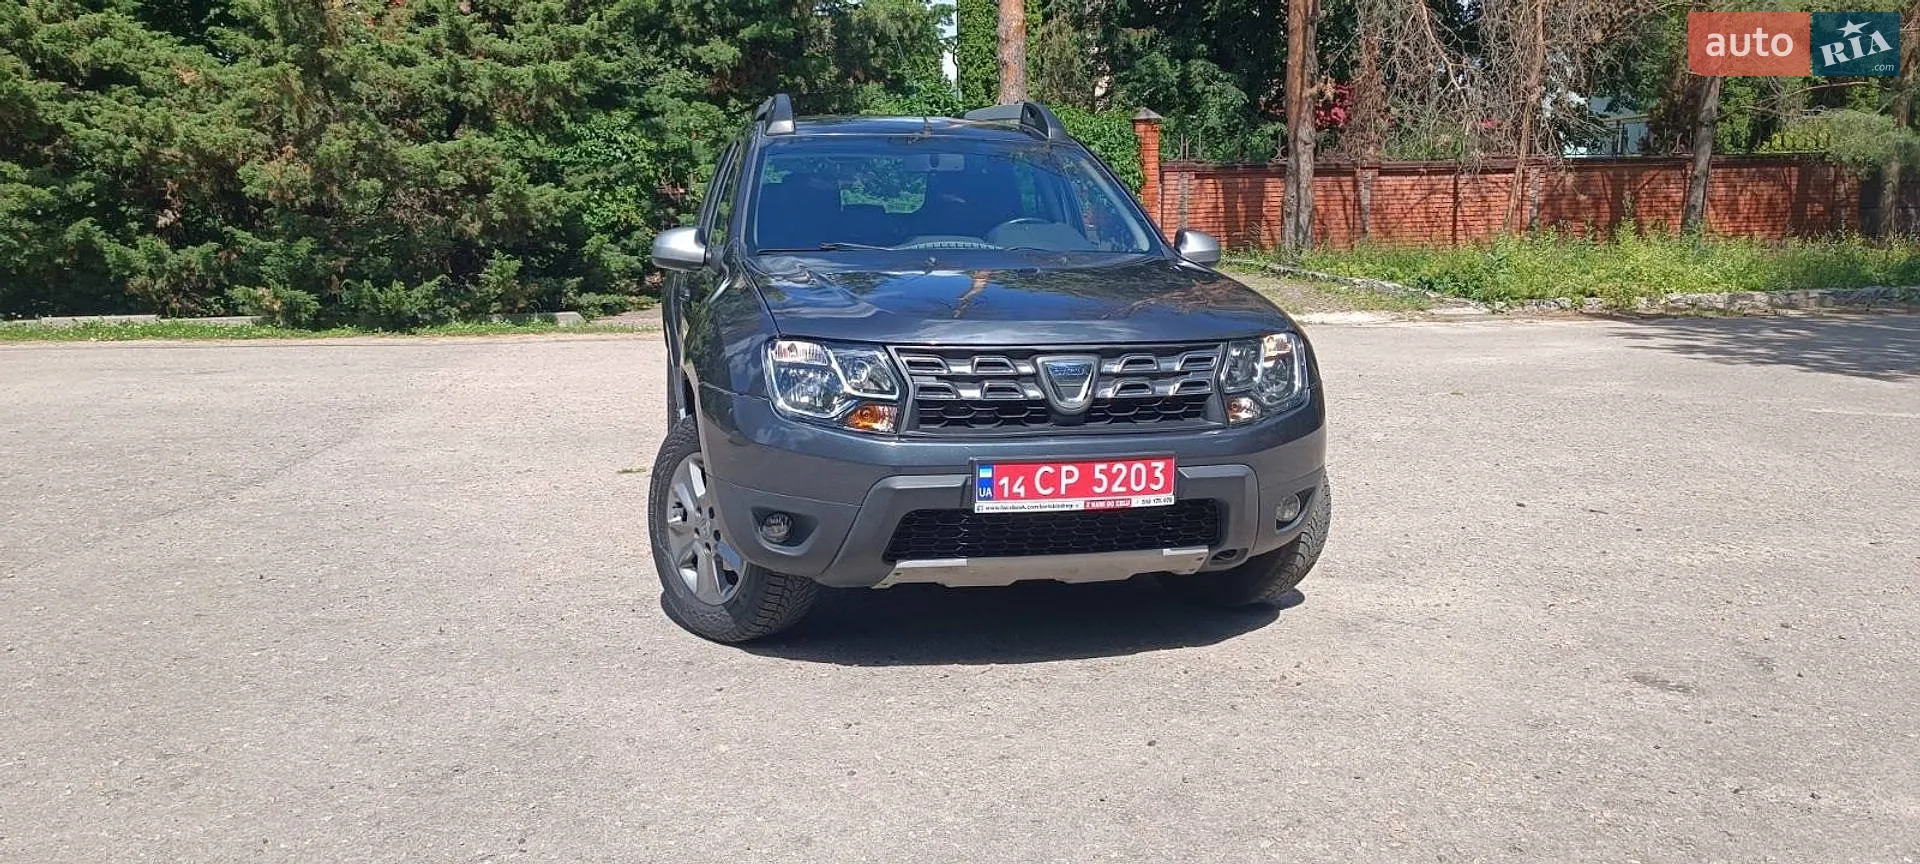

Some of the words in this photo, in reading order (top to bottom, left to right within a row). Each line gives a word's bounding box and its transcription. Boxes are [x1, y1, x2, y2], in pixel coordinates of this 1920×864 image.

[998, 476, 1026, 498] 14
[1034, 465, 1080, 496] CP
[1092, 461, 1166, 494] 5203
[979, 488, 993, 498] UA
